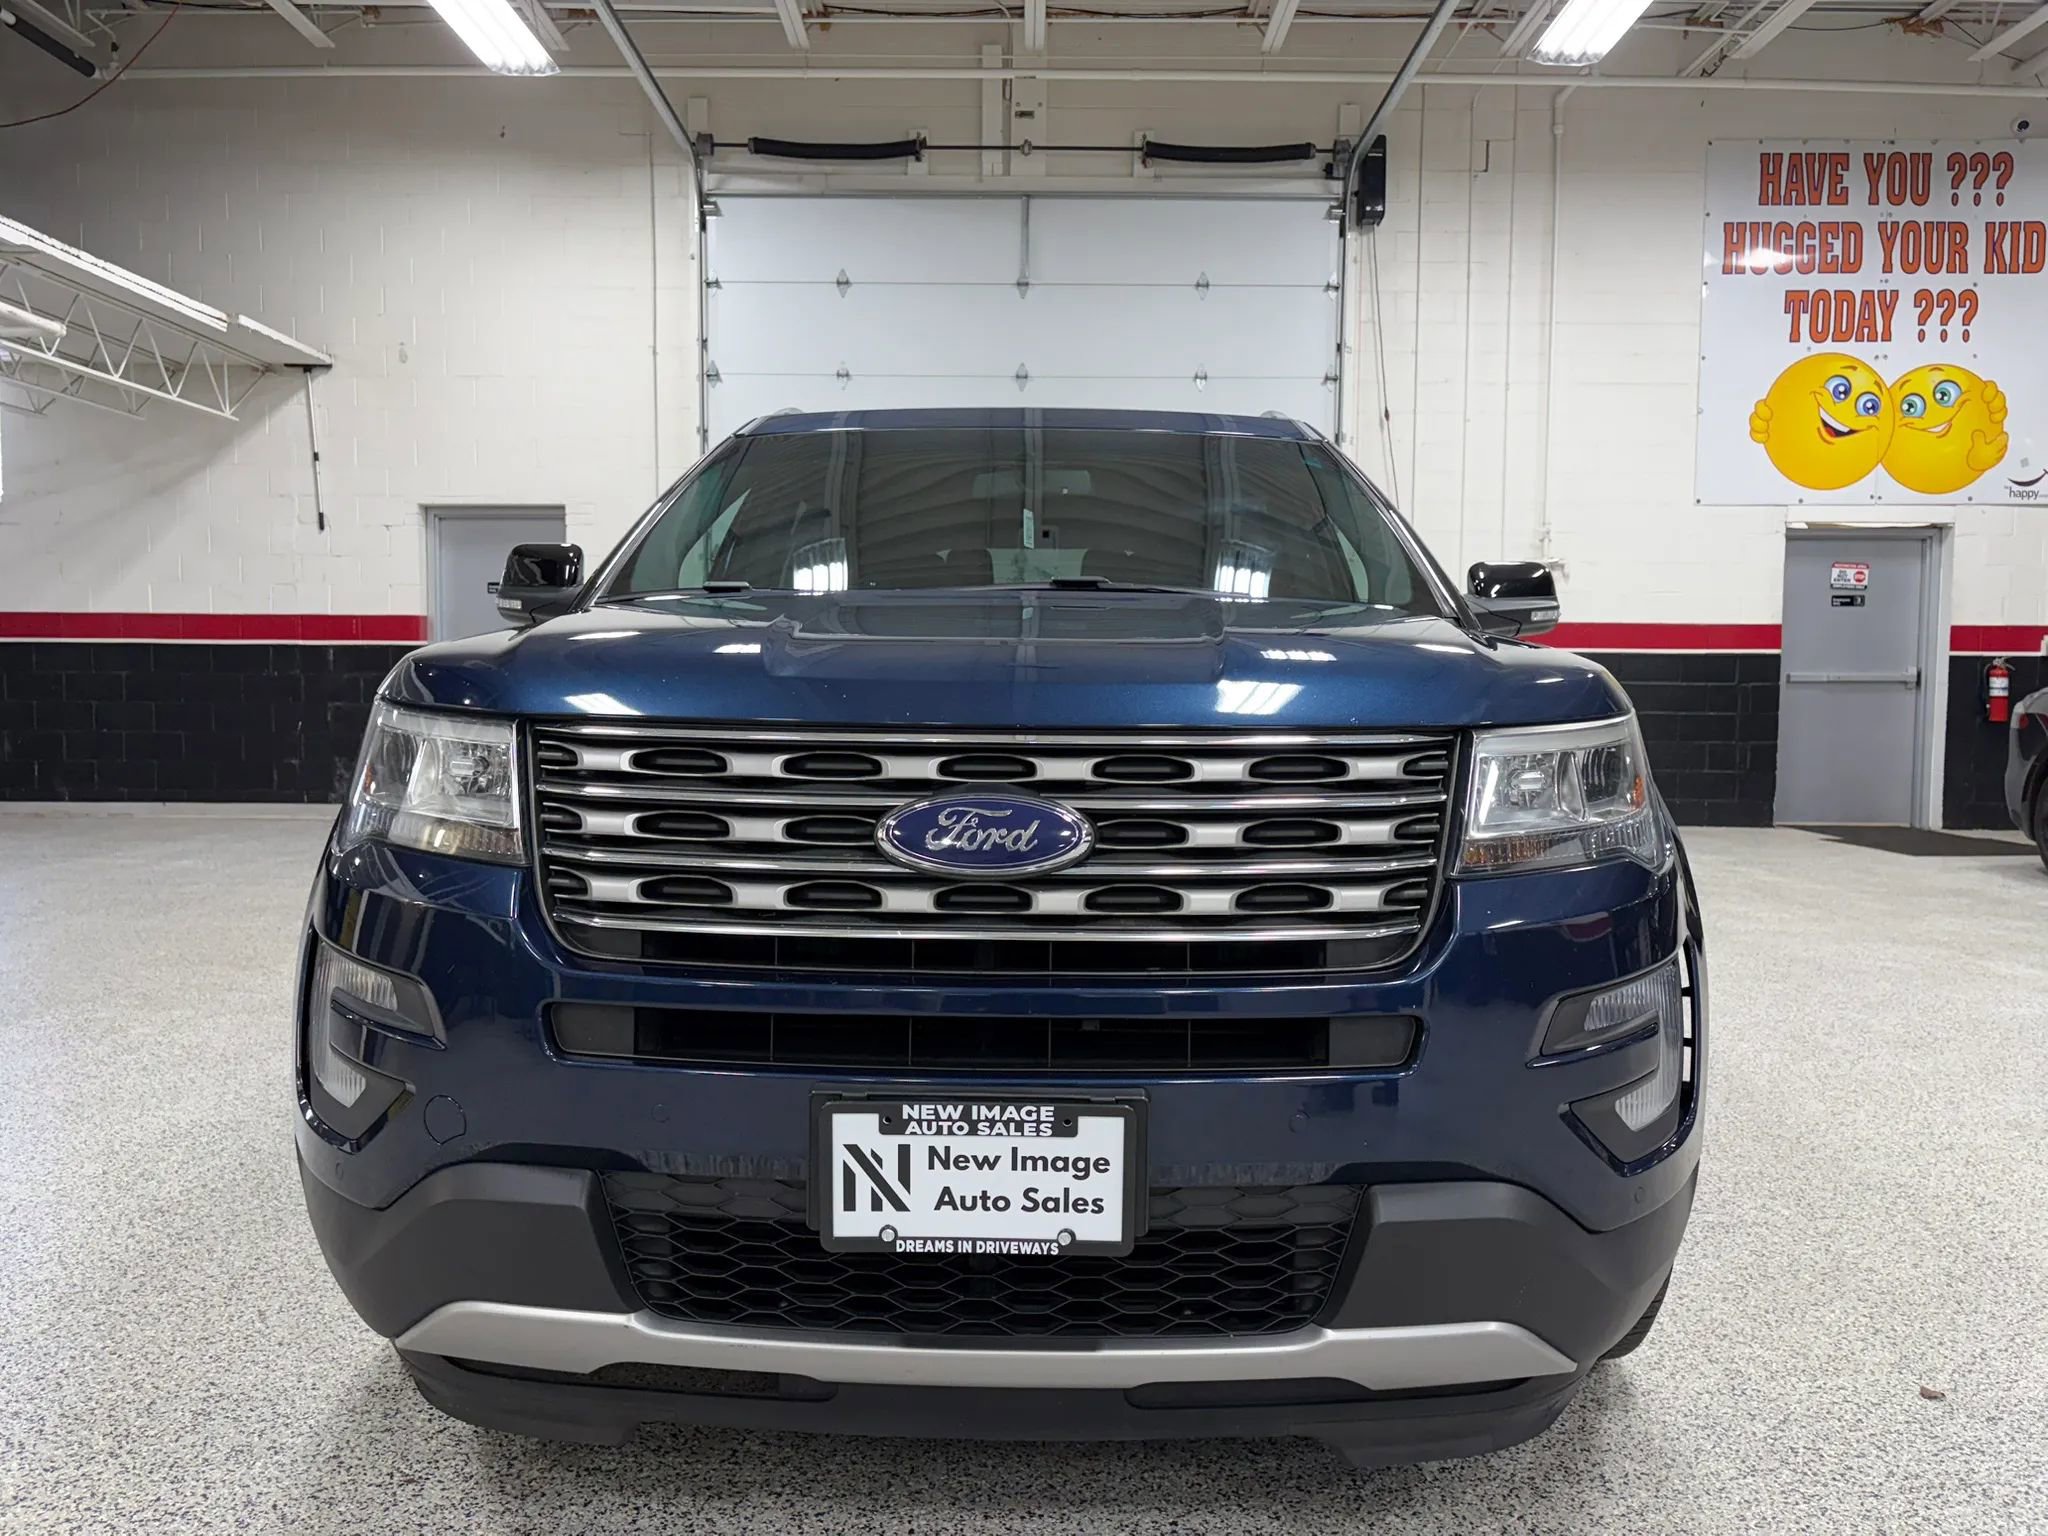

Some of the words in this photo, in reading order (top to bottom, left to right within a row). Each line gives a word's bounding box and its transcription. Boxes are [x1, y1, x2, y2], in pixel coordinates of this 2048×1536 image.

[1758, 152, 1849, 206] HAVE
[1864, 152, 1932, 206] YOU
[1947, 152, 2014, 207] ???
[1722, 221, 1863, 275] HUGGED
[1878, 221, 1969, 274] YOUR
[1984, 221, 2046, 274] KID
[1785, 289, 1899, 343] TODAY
[1914, 289, 1978, 343] ???
[2009, 486, 2039, 500] happy
[925, 806, 1040, 851] Ford
[902, 1104, 963, 1120] NEW
[972, 1106, 1055, 1122] IMAGE
[905, 1122, 969, 1135] AUTO
[977, 1122, 1053, 1136] SALES
[928, 1146, 1001, 1171] New
[1011, 1147, 1110, 1181] Image
[934, 1187, 1011, 1213] Auto
[1021, 1188, 1104, 1214] Sales
[896, 1240, 954, 1253] DREAMS
[958, 1241, 972, 1253] IN
[976, 1241, 1059, 1255] DRIVEWAYS
